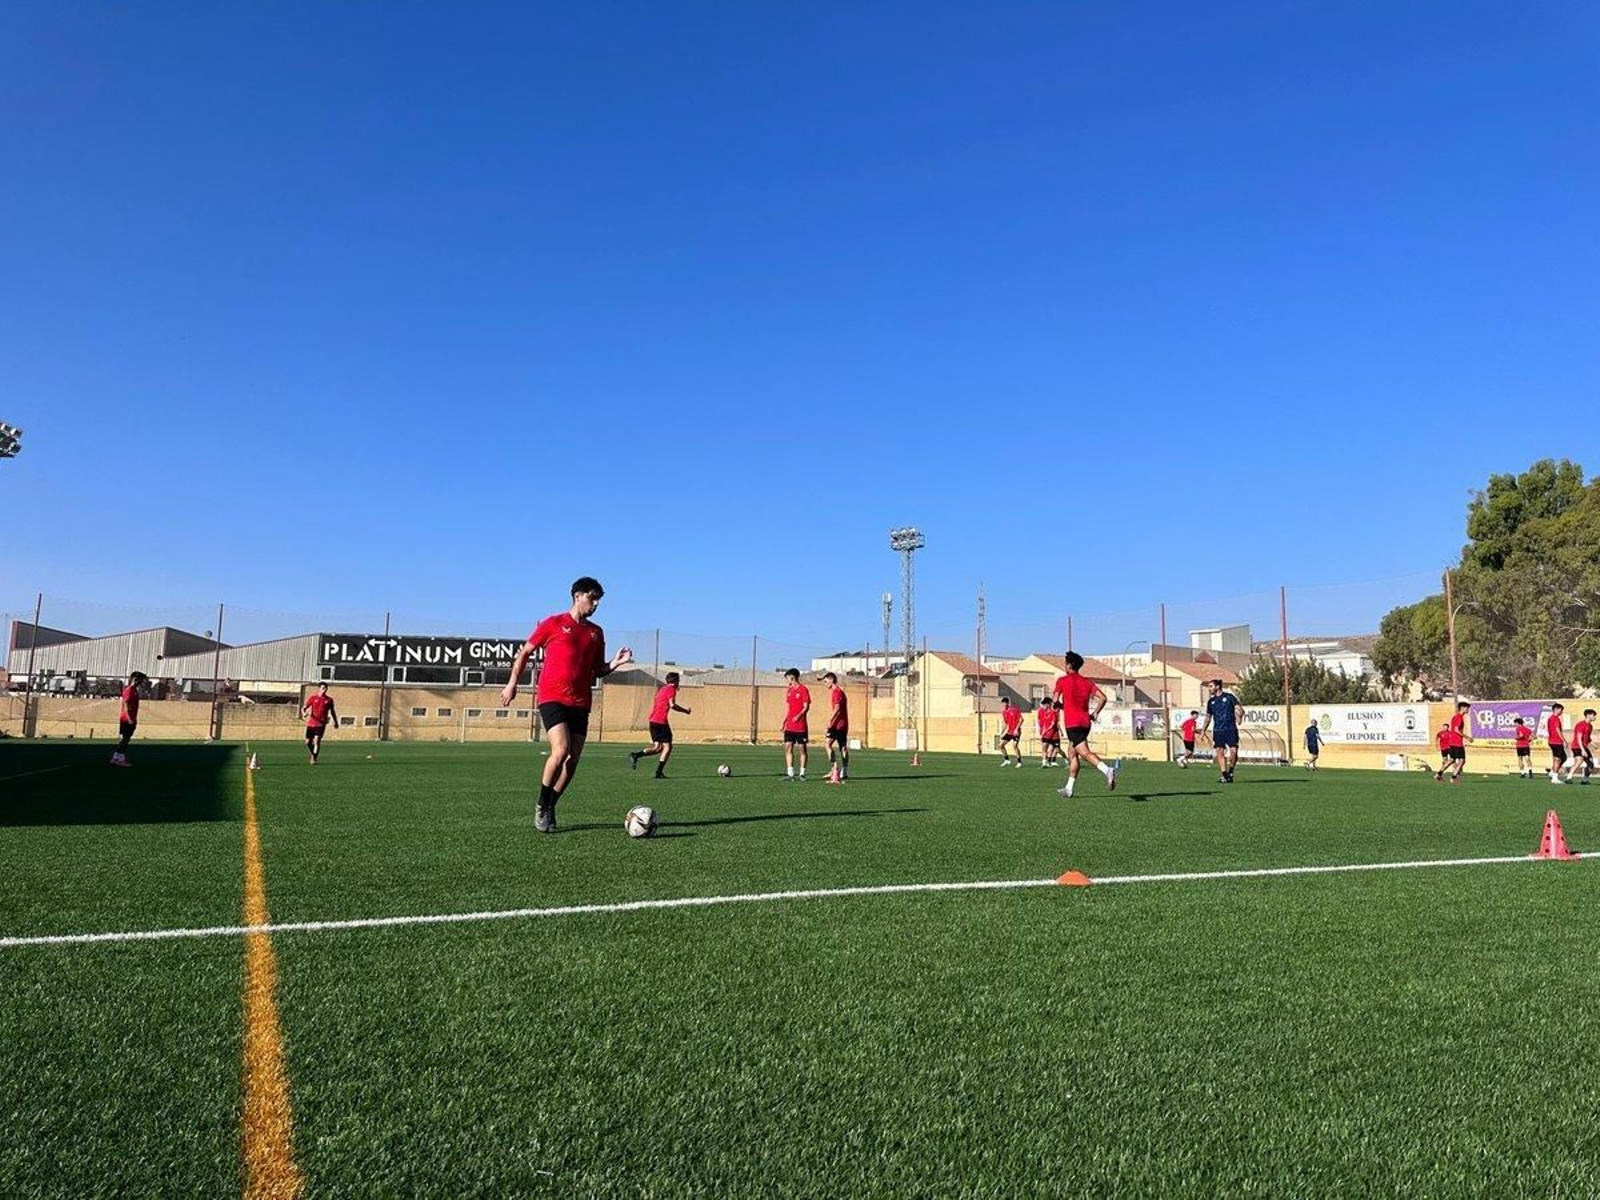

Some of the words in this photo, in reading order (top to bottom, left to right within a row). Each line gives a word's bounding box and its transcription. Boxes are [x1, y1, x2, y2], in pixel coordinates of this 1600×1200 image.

[324, 640, 462, 663] PLATINUM
[1347, 711, 1384, 720] ILUSIÓN
[1346, 732, 1387, 741] DEPORTE
